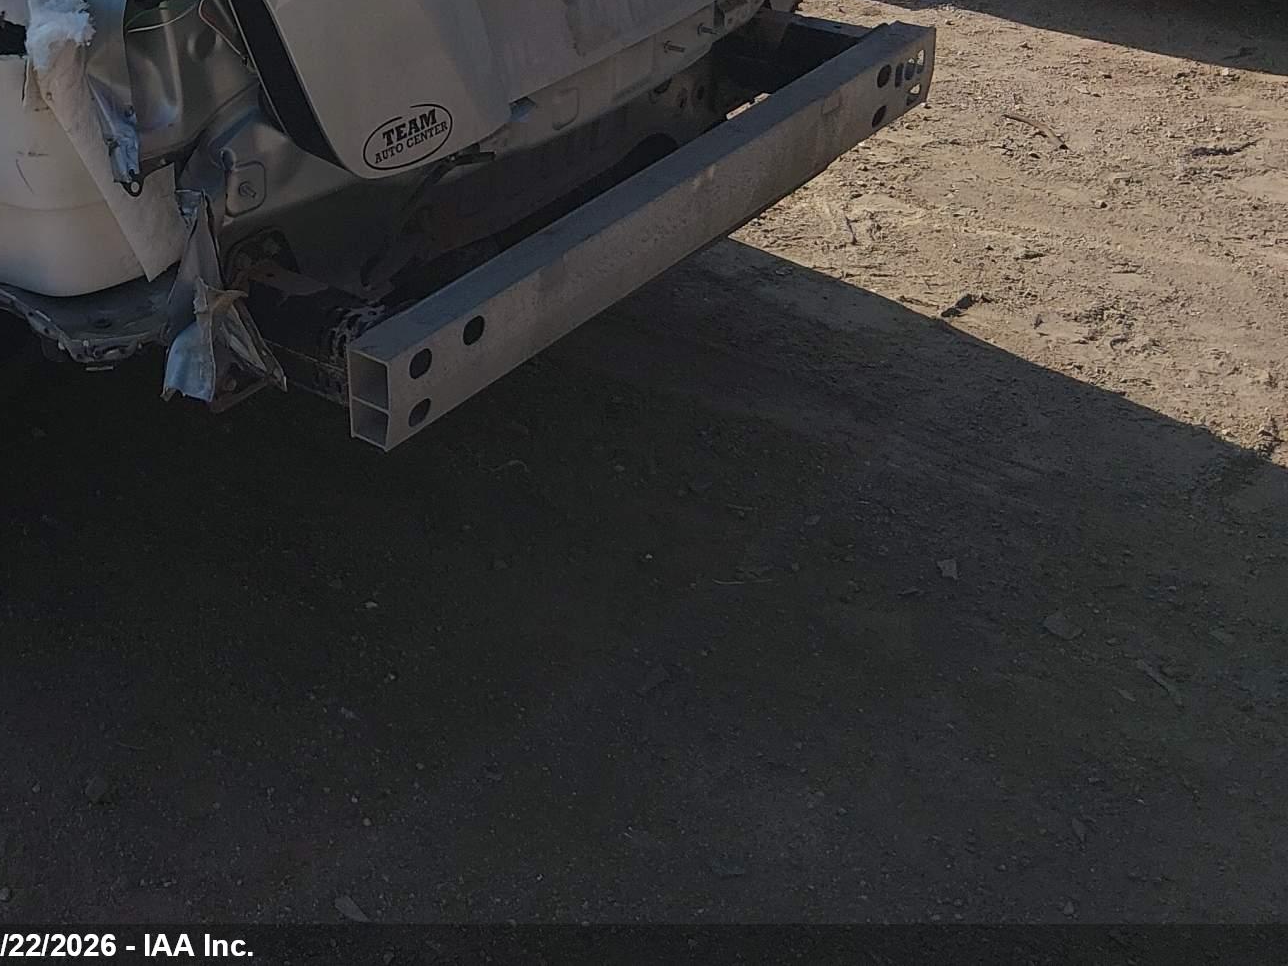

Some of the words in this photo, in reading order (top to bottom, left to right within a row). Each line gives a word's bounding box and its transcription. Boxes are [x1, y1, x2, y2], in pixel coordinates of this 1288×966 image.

[374, 142, 404, 164] AUTO
[406, 120, 449, 149] CENTER
[382, 108, 438, 147] TEAM
